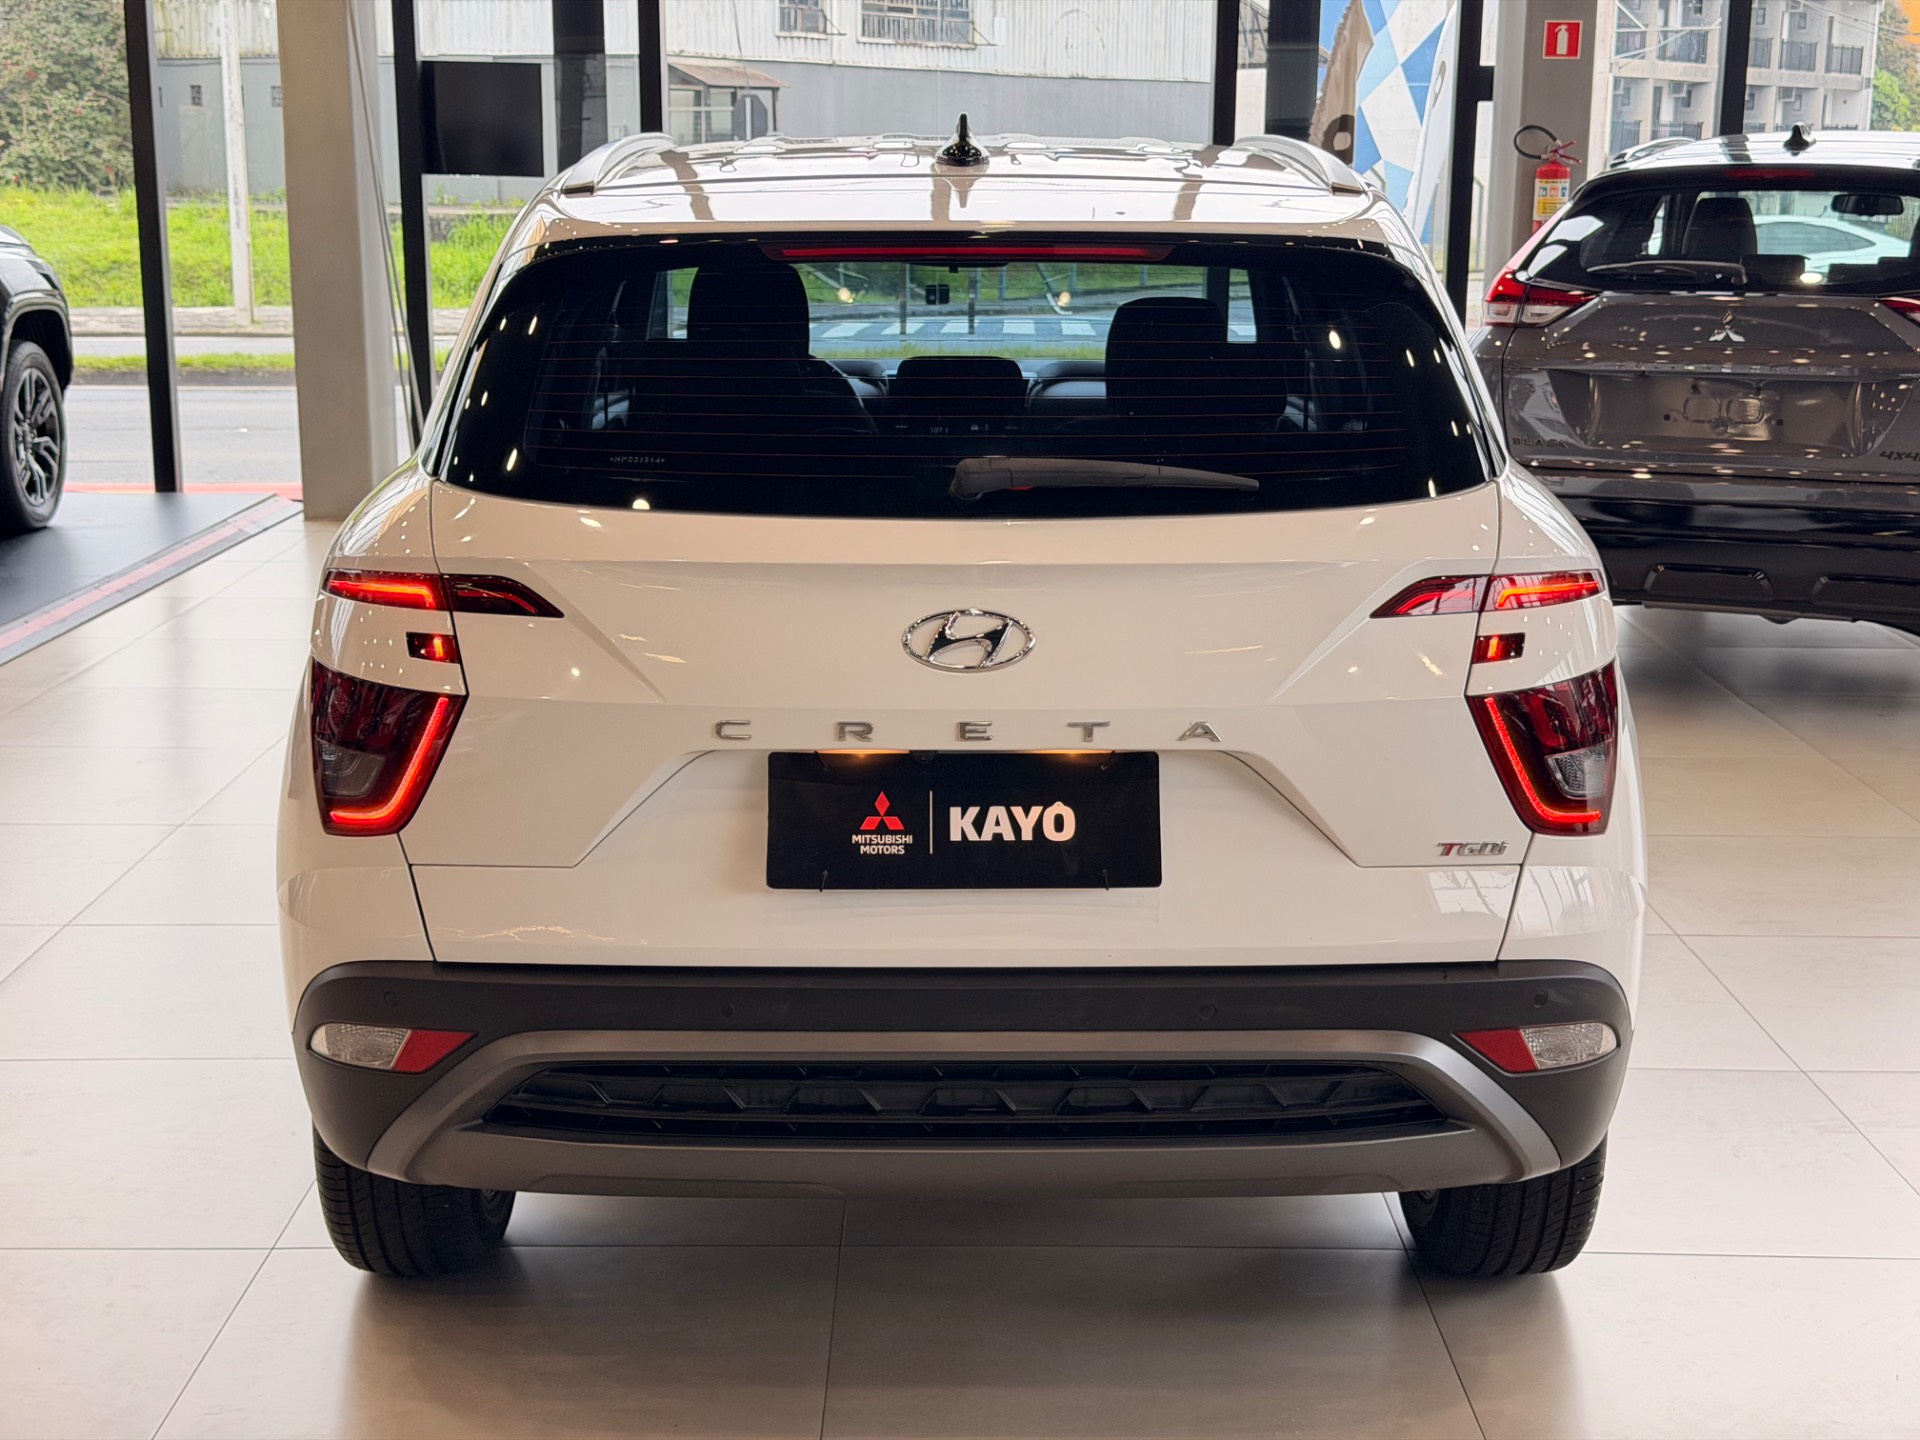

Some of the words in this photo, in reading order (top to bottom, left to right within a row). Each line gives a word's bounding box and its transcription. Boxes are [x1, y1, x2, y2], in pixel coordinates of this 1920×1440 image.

[1512, 436, 1569, 449] BLACK
[714, 719, 1223, 742] CRETA
[949, 801, 1076, 842] KAYÔ
[851, 834, 913, 844] MITSUBISHI
[860, 845, 905, 855] MOTORS
